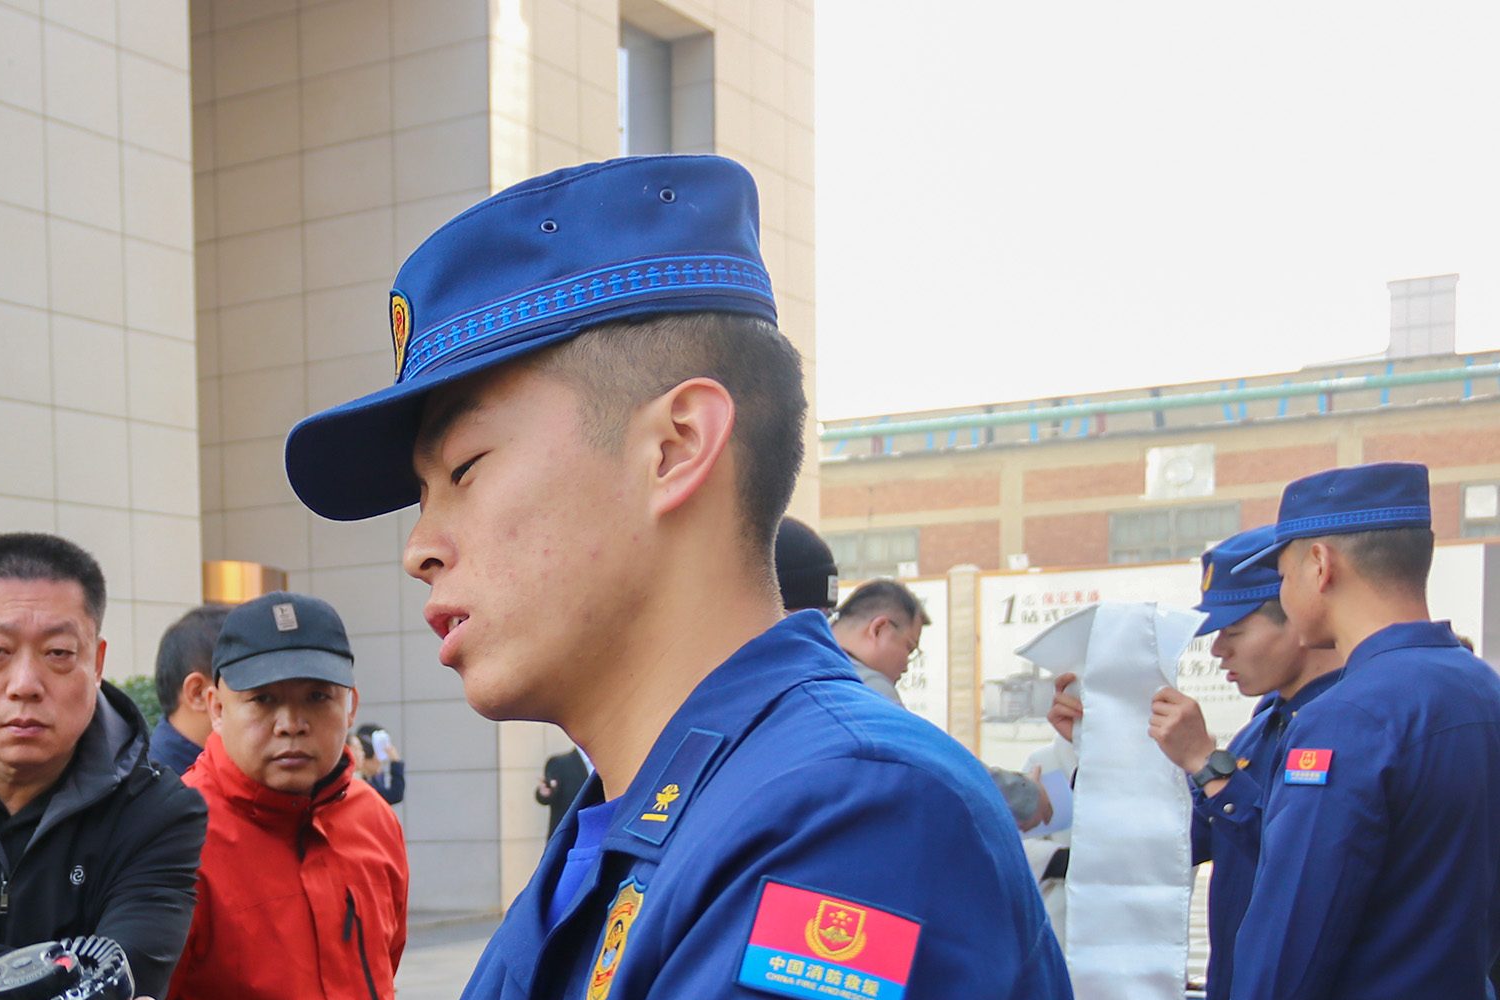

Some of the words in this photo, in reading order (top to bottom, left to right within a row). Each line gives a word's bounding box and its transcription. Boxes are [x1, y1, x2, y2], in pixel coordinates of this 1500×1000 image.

[766, 972, 795, 985] CHINA
[795, 978, 818, 990] FIRE
[817, 984, 841, 996] AND
[769, 956, 880, 997] 中国消防救援
